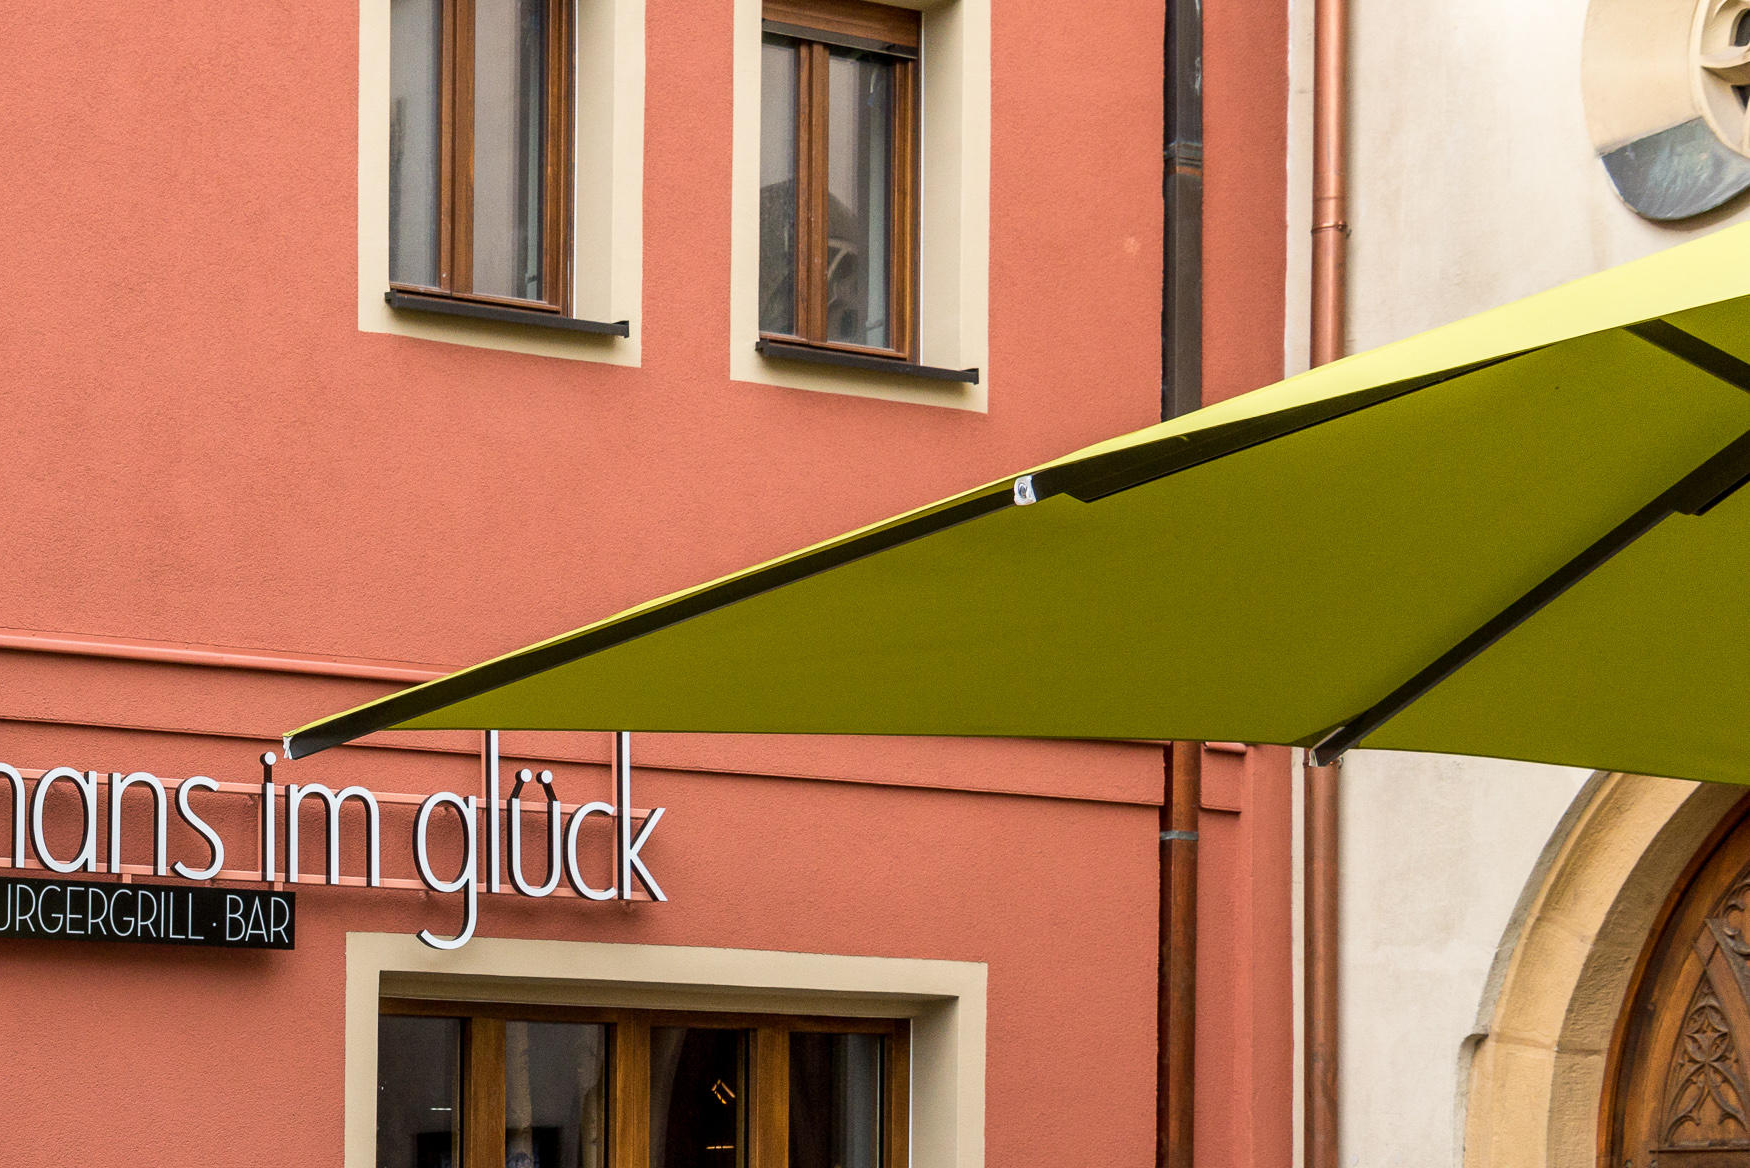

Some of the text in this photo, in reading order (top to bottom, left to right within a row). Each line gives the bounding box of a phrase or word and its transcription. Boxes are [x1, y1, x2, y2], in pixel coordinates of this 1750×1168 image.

[260, 751, 380, 887] im
[415, 731, 668, 950] glück
[225, 894, 290, 944] BAR
